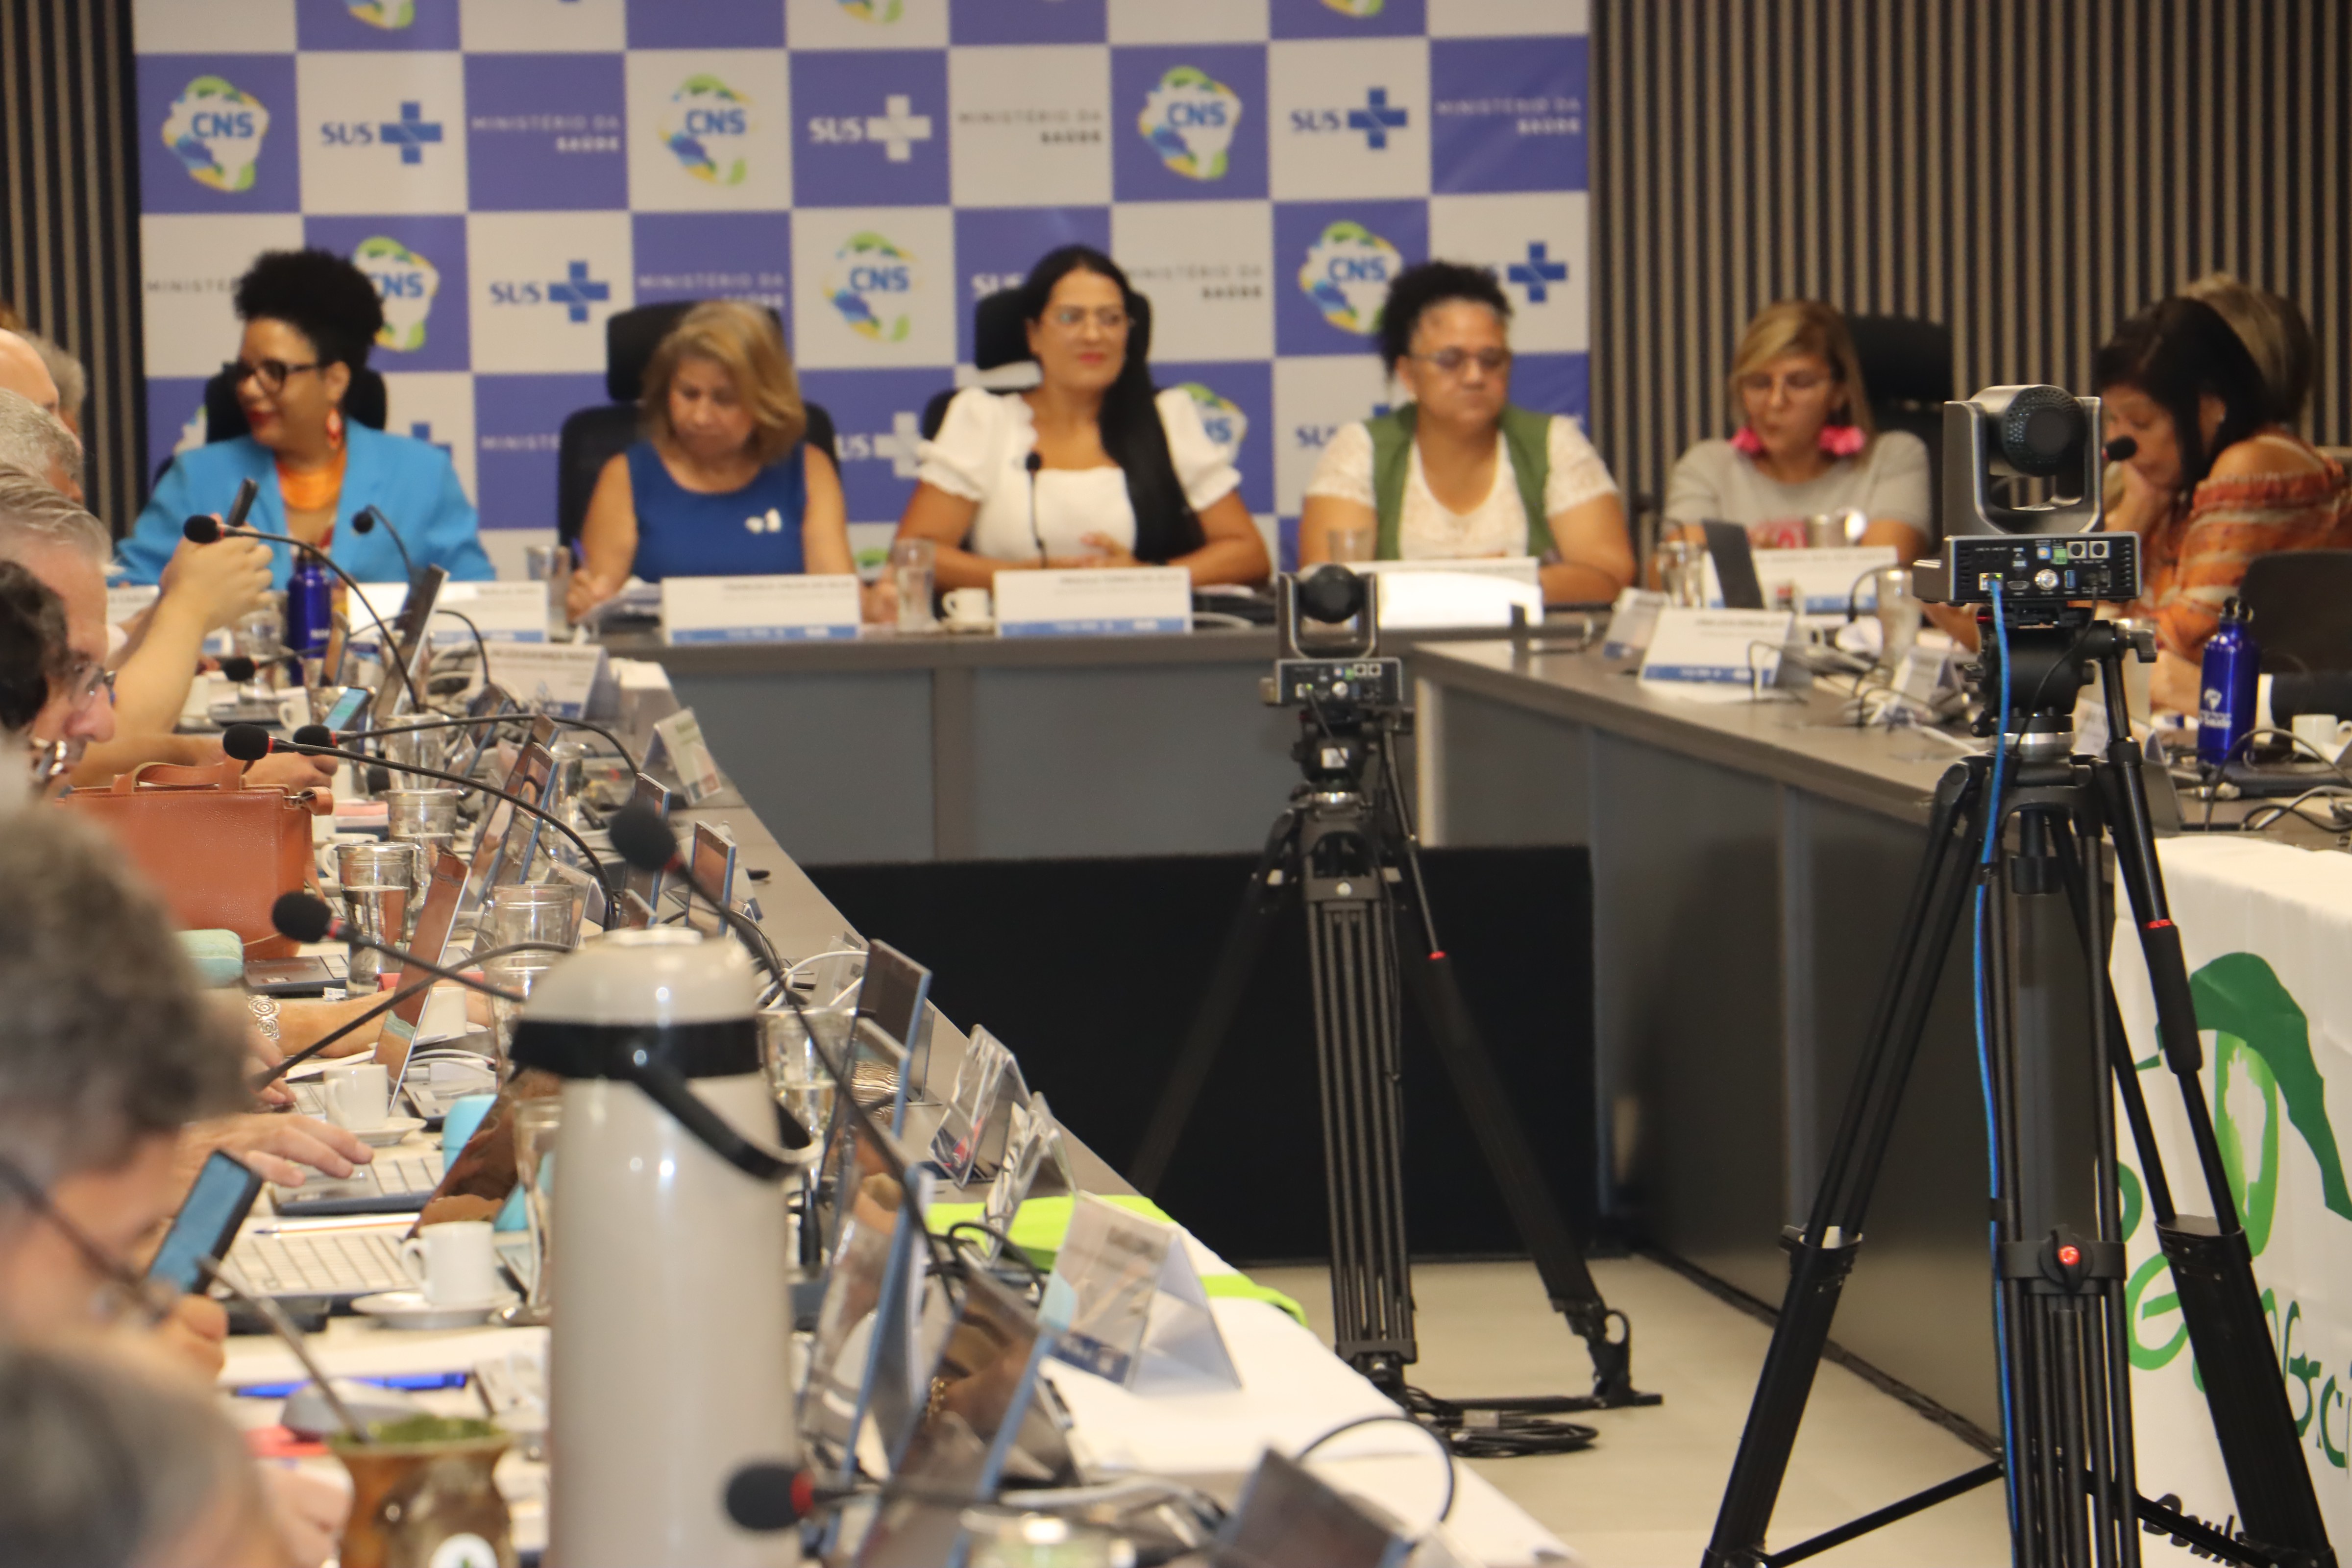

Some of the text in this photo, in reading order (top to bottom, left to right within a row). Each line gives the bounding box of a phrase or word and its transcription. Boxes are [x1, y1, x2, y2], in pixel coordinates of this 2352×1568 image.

[191, 112, 254, 138] CNS
[593, 115, 619, 130] DA
[686, 109, 746, 135] CNS
[1166, 101, 1226, 127] CNS
[1290, 109, 1341, 133] SUS
[321, 122, 373, 146] SUS
[808, 117, 862, 143] SUS
[851, 267, 910, 292] CNS
[1128, 265, 1228, 283] INISTÉRIO
[1328, 256, 1387, 283] CNS
[490, 282, 542, 305] SUS
[1202, 417, 1232, 443] NS
[833, 433, 870, 461] US
